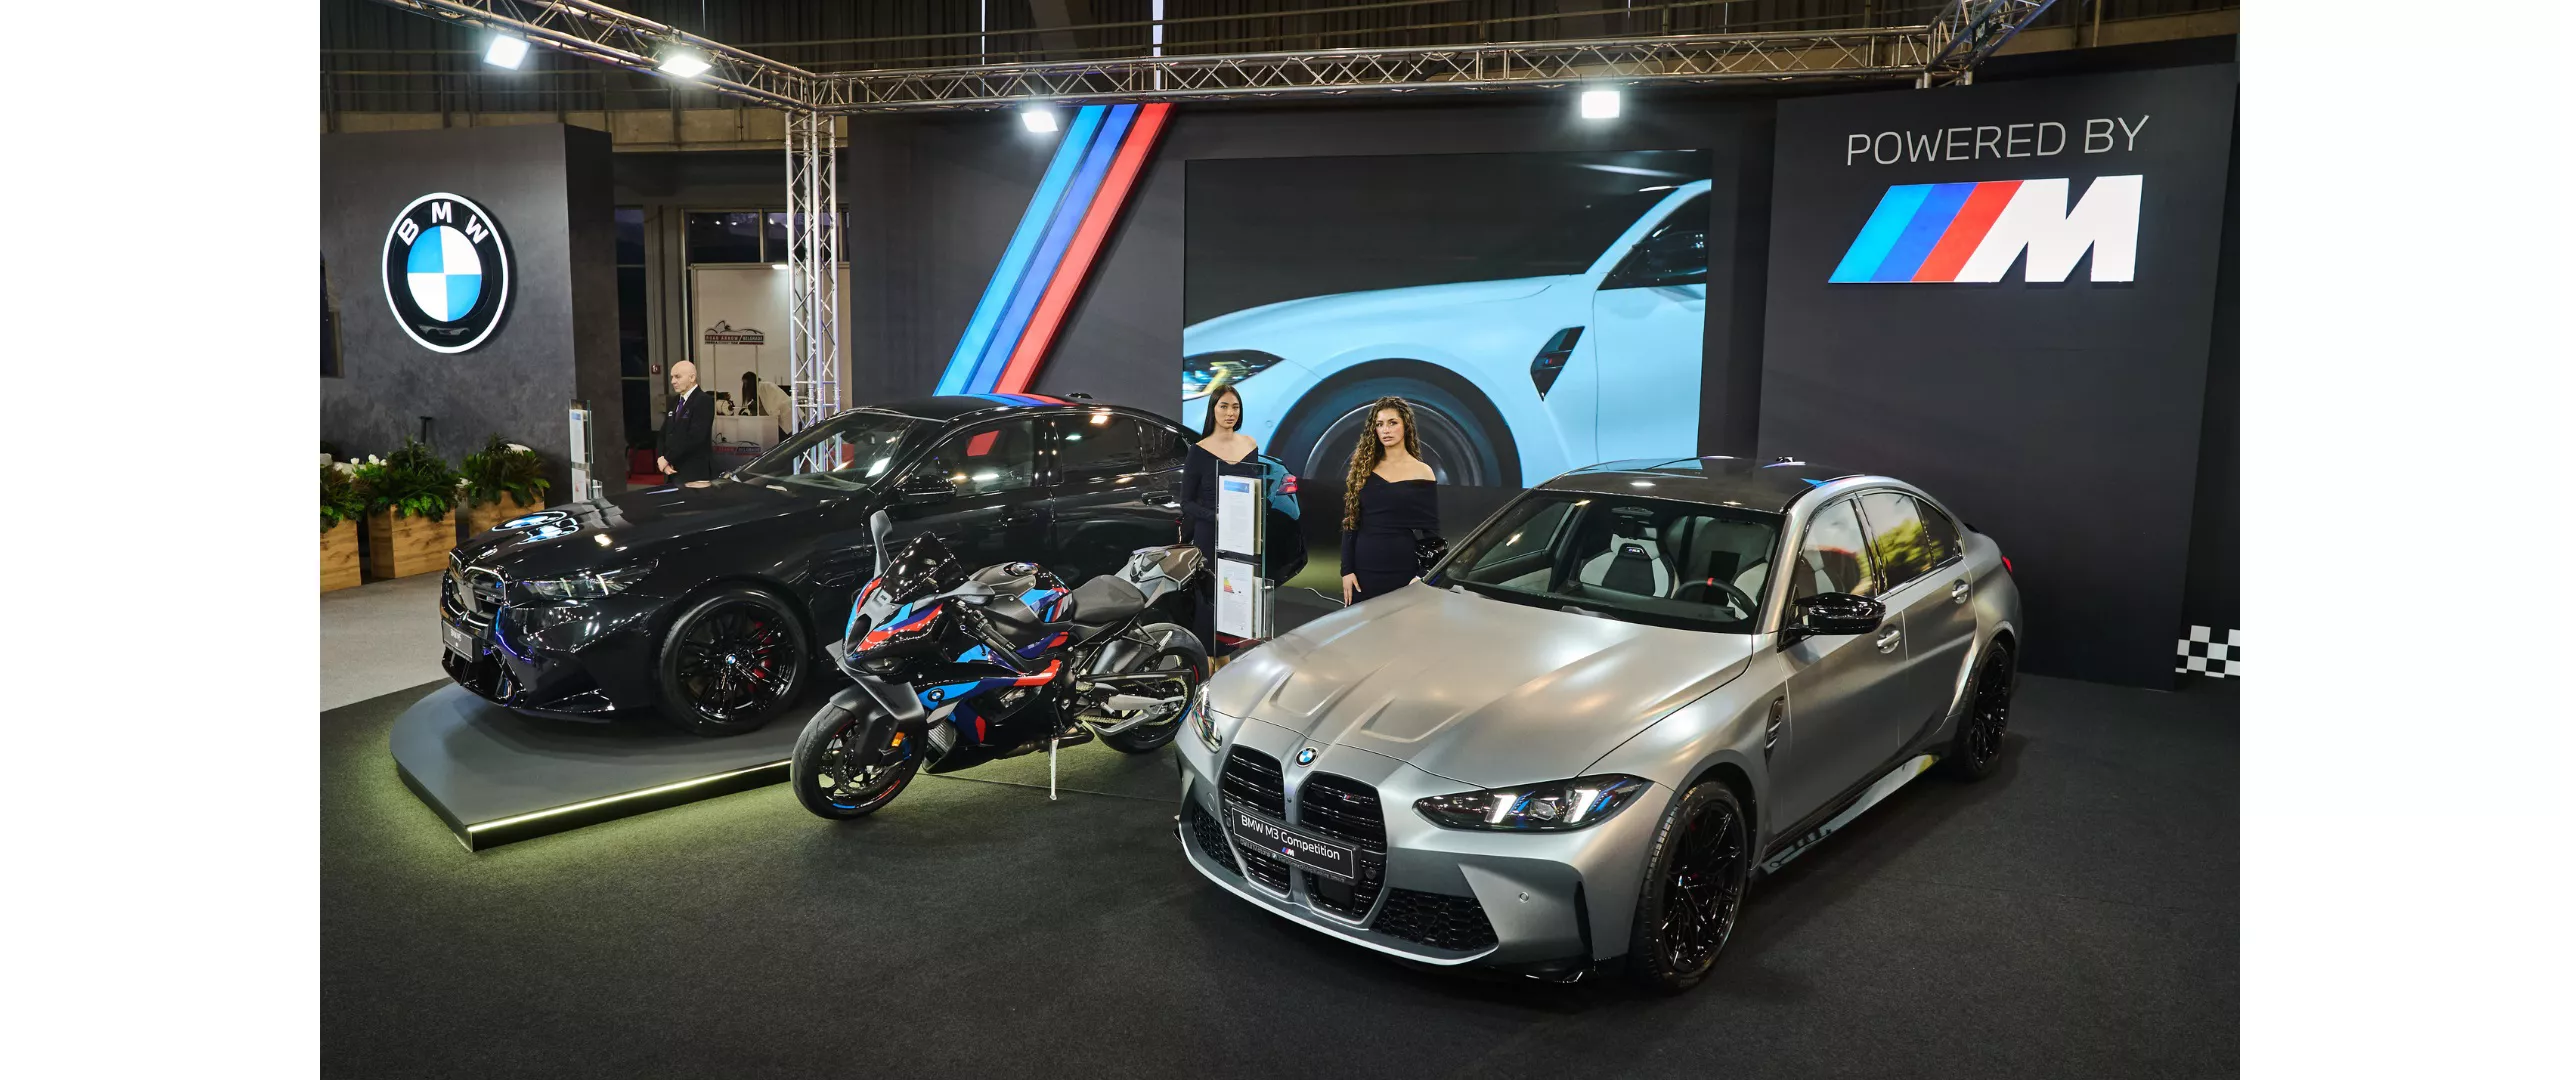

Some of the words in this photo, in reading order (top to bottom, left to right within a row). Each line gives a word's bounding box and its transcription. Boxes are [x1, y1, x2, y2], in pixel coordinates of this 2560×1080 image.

[1847, 121, 2066, 165] POWERED
[2084, 115, 2150, 154] BY
[397, 201, 489, 246] BMW
[1954, 174, 2144, 283] M
[1241, 814, 1263, 834] BMW
[1265, 826, 1279, 840] M3
[1281, 831, 1340, 860] Competition
